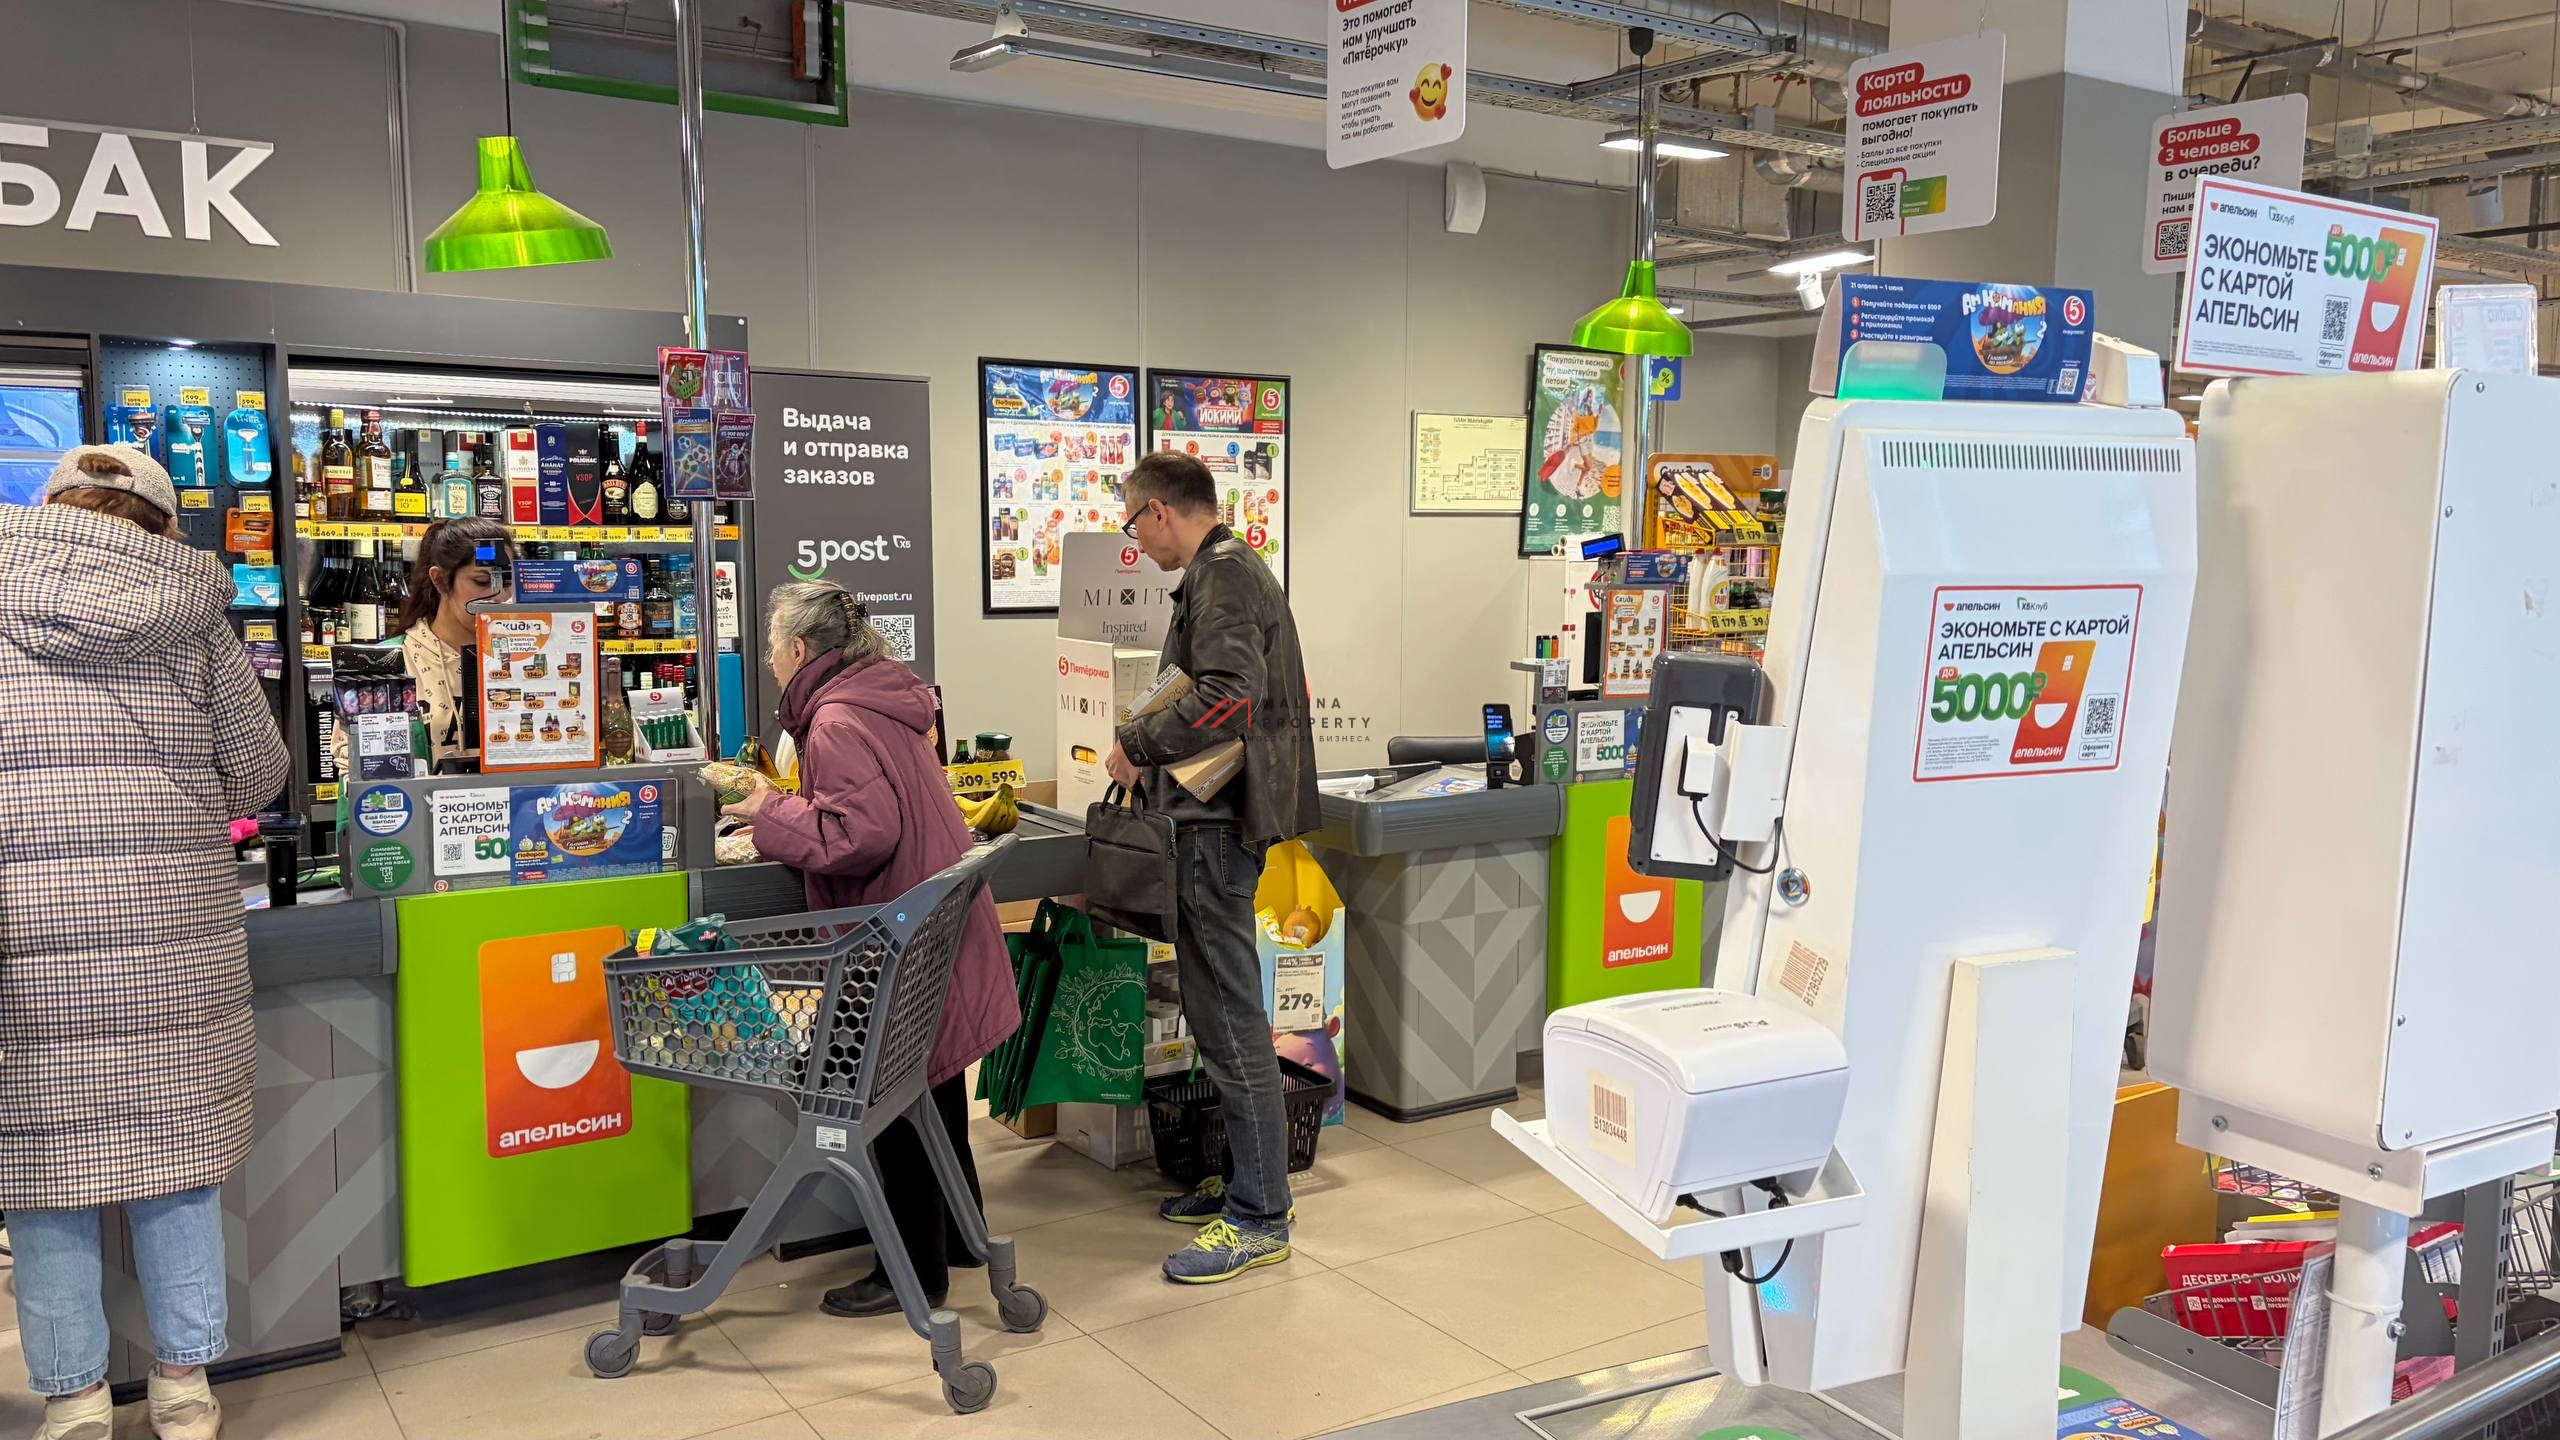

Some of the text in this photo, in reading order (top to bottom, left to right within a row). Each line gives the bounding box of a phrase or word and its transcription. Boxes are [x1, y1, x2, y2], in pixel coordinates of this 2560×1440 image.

[1342, 19, 1360, 32] Это
[1363, 0, 1413, 25] помогает
[1342, 17, 1416, 49] нам улучшать
[1342, 38, 1408, 65] «Пятёрочку»
[1342, 78, 1399, 99] После покупки вам
[1864, 69, 1916, 92] Карта
[1342, 91, 1391, 109] могут позвонить
[1863, 81, 1963, 112] лояльности
[1342, 115, 1380, 130] чтобы узнать
[1862, 102, 1978, 132] помогает покупать
[1353, 129, 1362, 137] мы
[1862, 127, 1913, 146] выгодно!
[2167, 123, 2232, 144] Больше
[1861, 139, 1942, 159] Баллы за все покупки
[2165, 139, 2250, 162] 3 человек
[1861, 150, 1936, 168] Специальные акции
[2164, 156, 2261, 182] в очереди?
[0, 122, 280, 247] БАК
[2162, 205, 2185, 215] нам
[2220, 203, 2257, 219] апельсин
[2204, 233, 2319, 273] ЭКОНОМЬТЕ
[2201, 267, 2294, 301] С КАРТОЙ
[1861, 299, 1893, 309] Получайте
[1894, 302, 1919, 310] подарок
[1906, 315, 1935, 323] промокод
[2196, 299, 2300, 333] АПЕЛЬСИН
[1547, 355, 1584, 365] Покупайте
[2352, 352, 2394, 368] апельсин
[783, 407, 871, 431] Выдача
[1199, 405, 1242, 424] ЙОКИМИ
[784, 440, 909, 462] и отправка
[575, 473, 593, 482] VSOP
[784, 468, 875, 486] заказов
[856, 591, 913, 603] fivepost.ru
[1956, 602, 2000, 612] апельсин
[1102, 619, 1147, 637] Inspired
[1722, 617, 1736, 628] 179
[1941, 614, 2130, 639] ЭКОНОМЬТЕ С КАРТОЙ
[1938, 641, 2033, 660] АПЕЛЬСИН
[1070, 662, 1110, 680] Пятёрочка
[1586, 727, 1611, 736] КАРТОЙ
[2014, 746, 2063, 758] апельсин
[957, 770, 1017, 787] 309 599
[440, 809, 503, 825] С КАРТОЙ
[440, 823, 510, 836] АПЕЛЬСИН
[1607, 943, 1669, 963] апельсин
[1278, 992, 1314, 1011] 279
[499, 1111, 622, 1149] апельсин
[2181, 1273, 2229, 1287] ДЕСЕРТ
